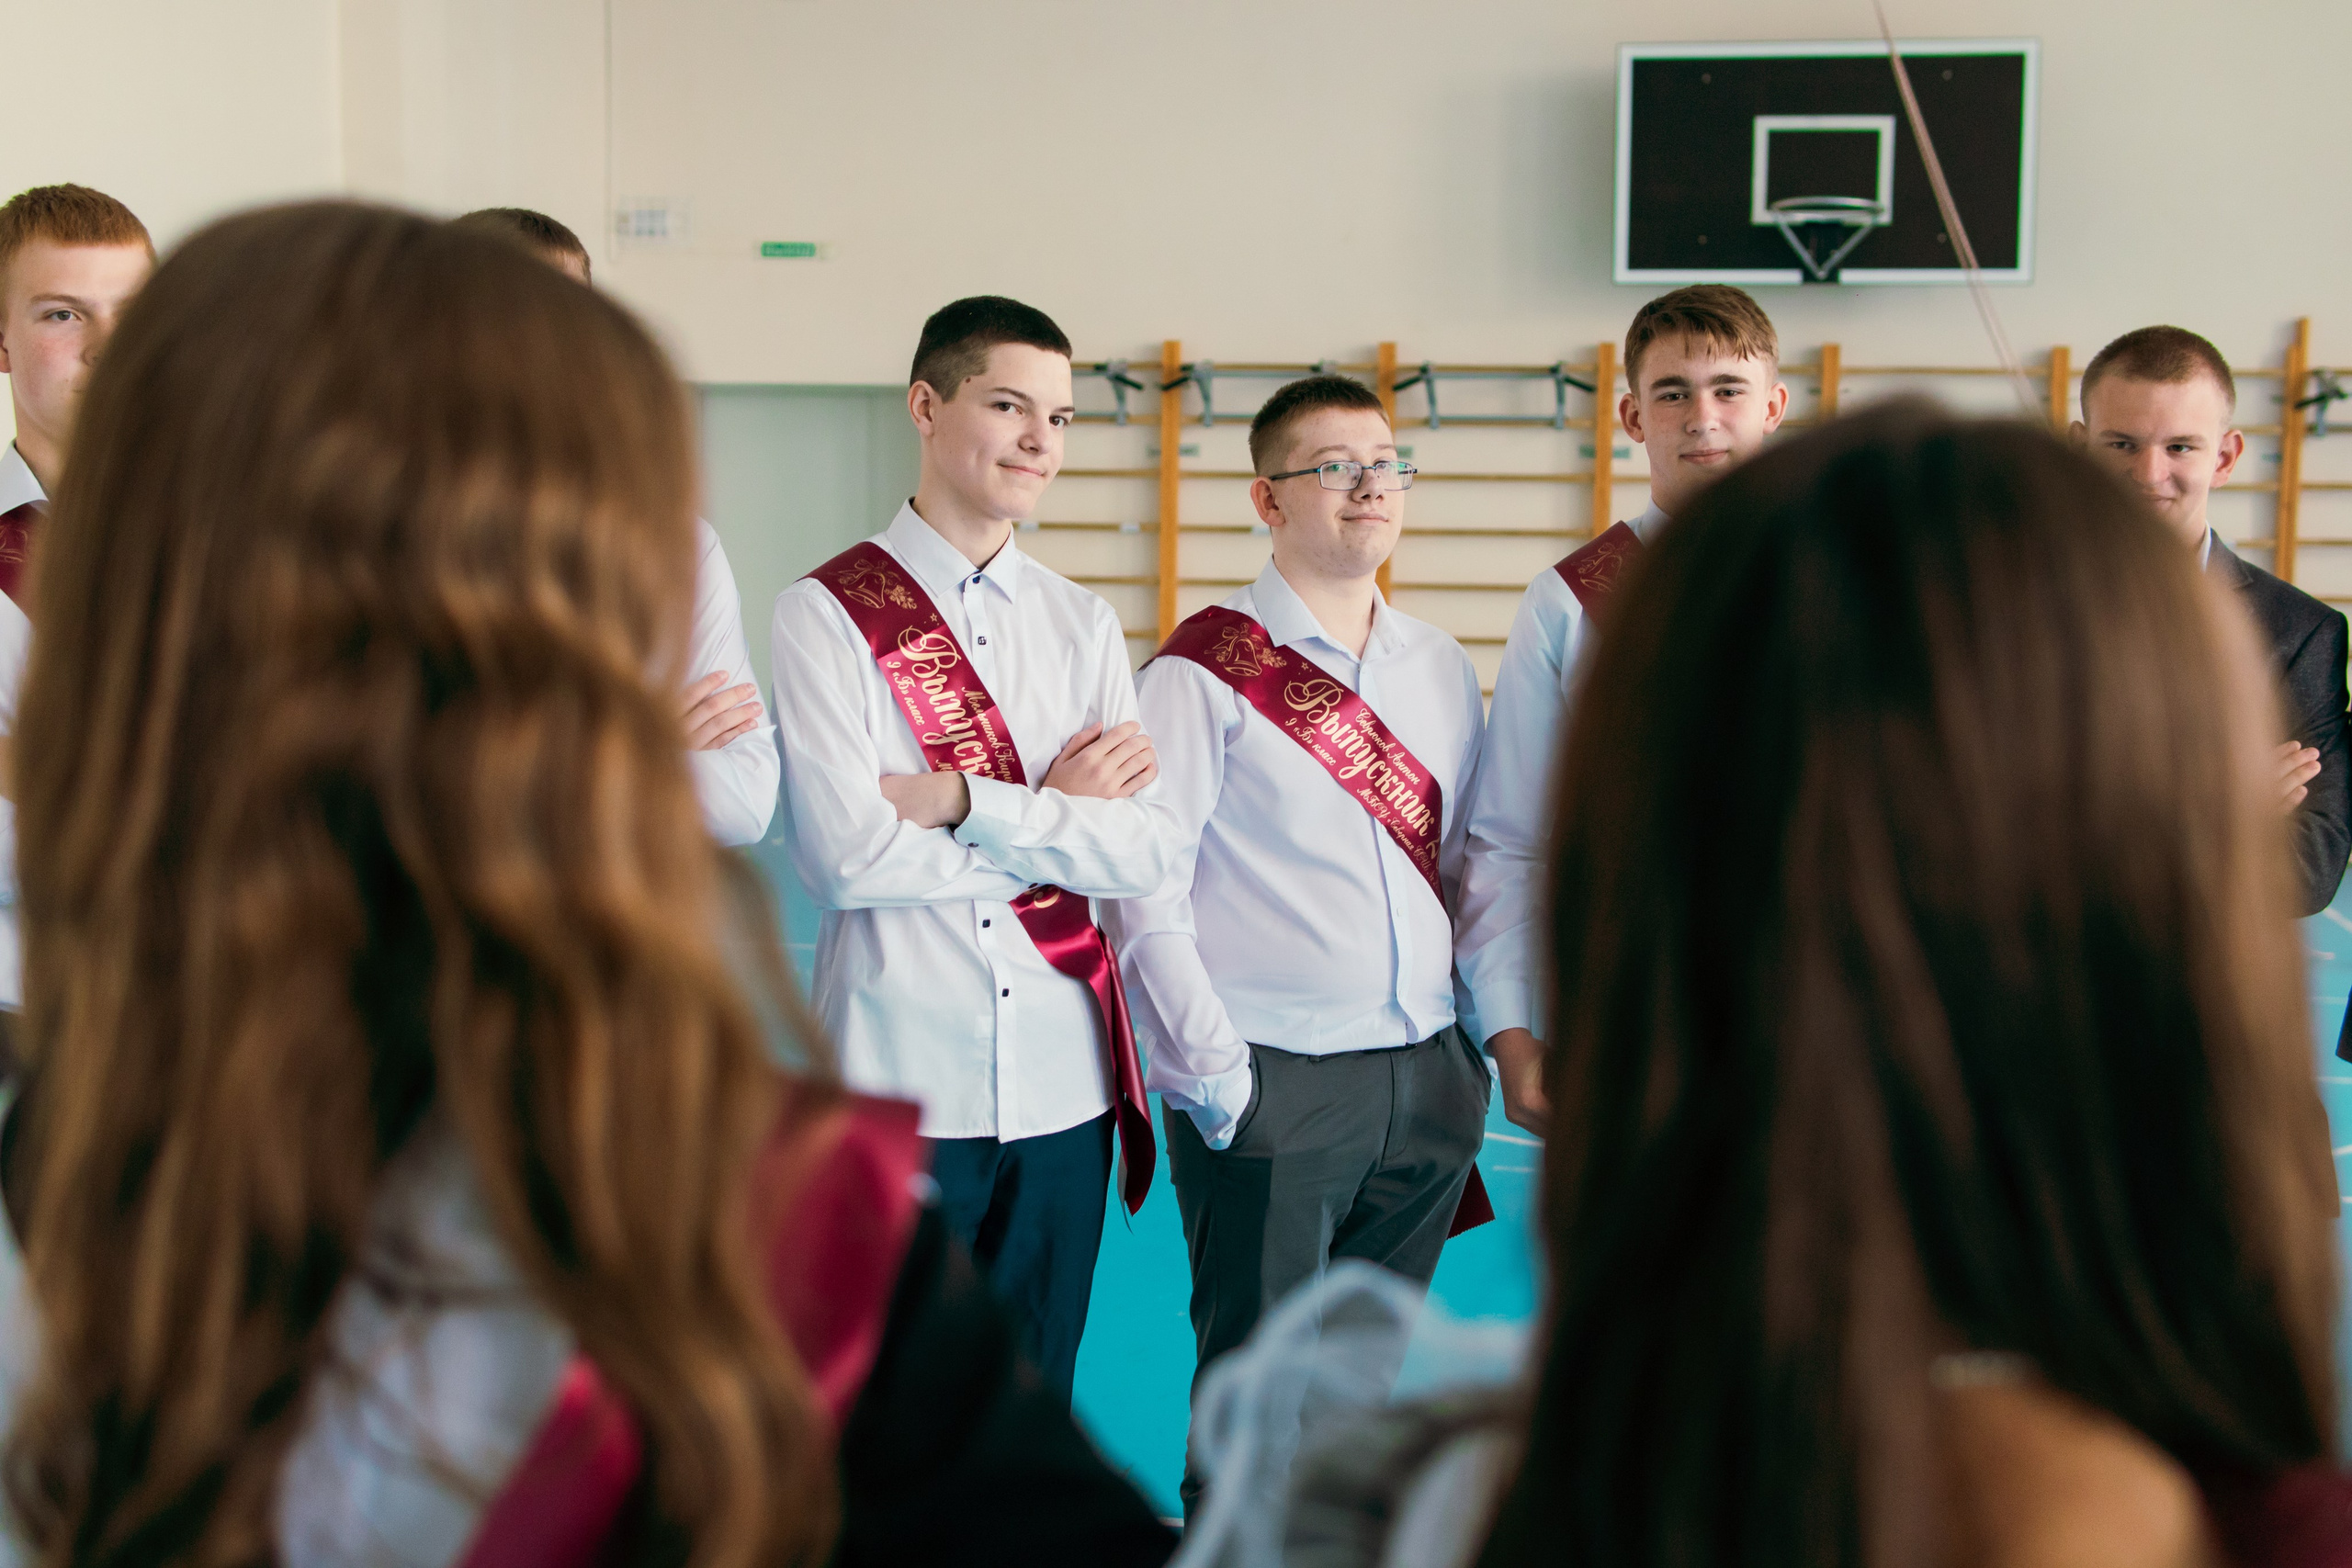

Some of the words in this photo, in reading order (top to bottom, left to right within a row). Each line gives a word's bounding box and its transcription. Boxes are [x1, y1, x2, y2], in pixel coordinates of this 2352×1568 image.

[887, 660, 902, 669] 9
[892, 671, 917, 695] «Б»
[904, 696, 925, 727] класс
[961, 686, 1009, 750] Мельников
[994, 749, 1016, 783] Кири
[1284, 717, 1297, 727] 9
[1293, 727, 1317, 744] «Б»
[1312, 743, 1337, 766] класс
[1355, 707, 1396, 752] Севрюков
[1386, 751, 1420, 785] Антон
[1283, 678, 1435, 837] Выпускник
[1356, 788, 1391, 819] МБОУ
